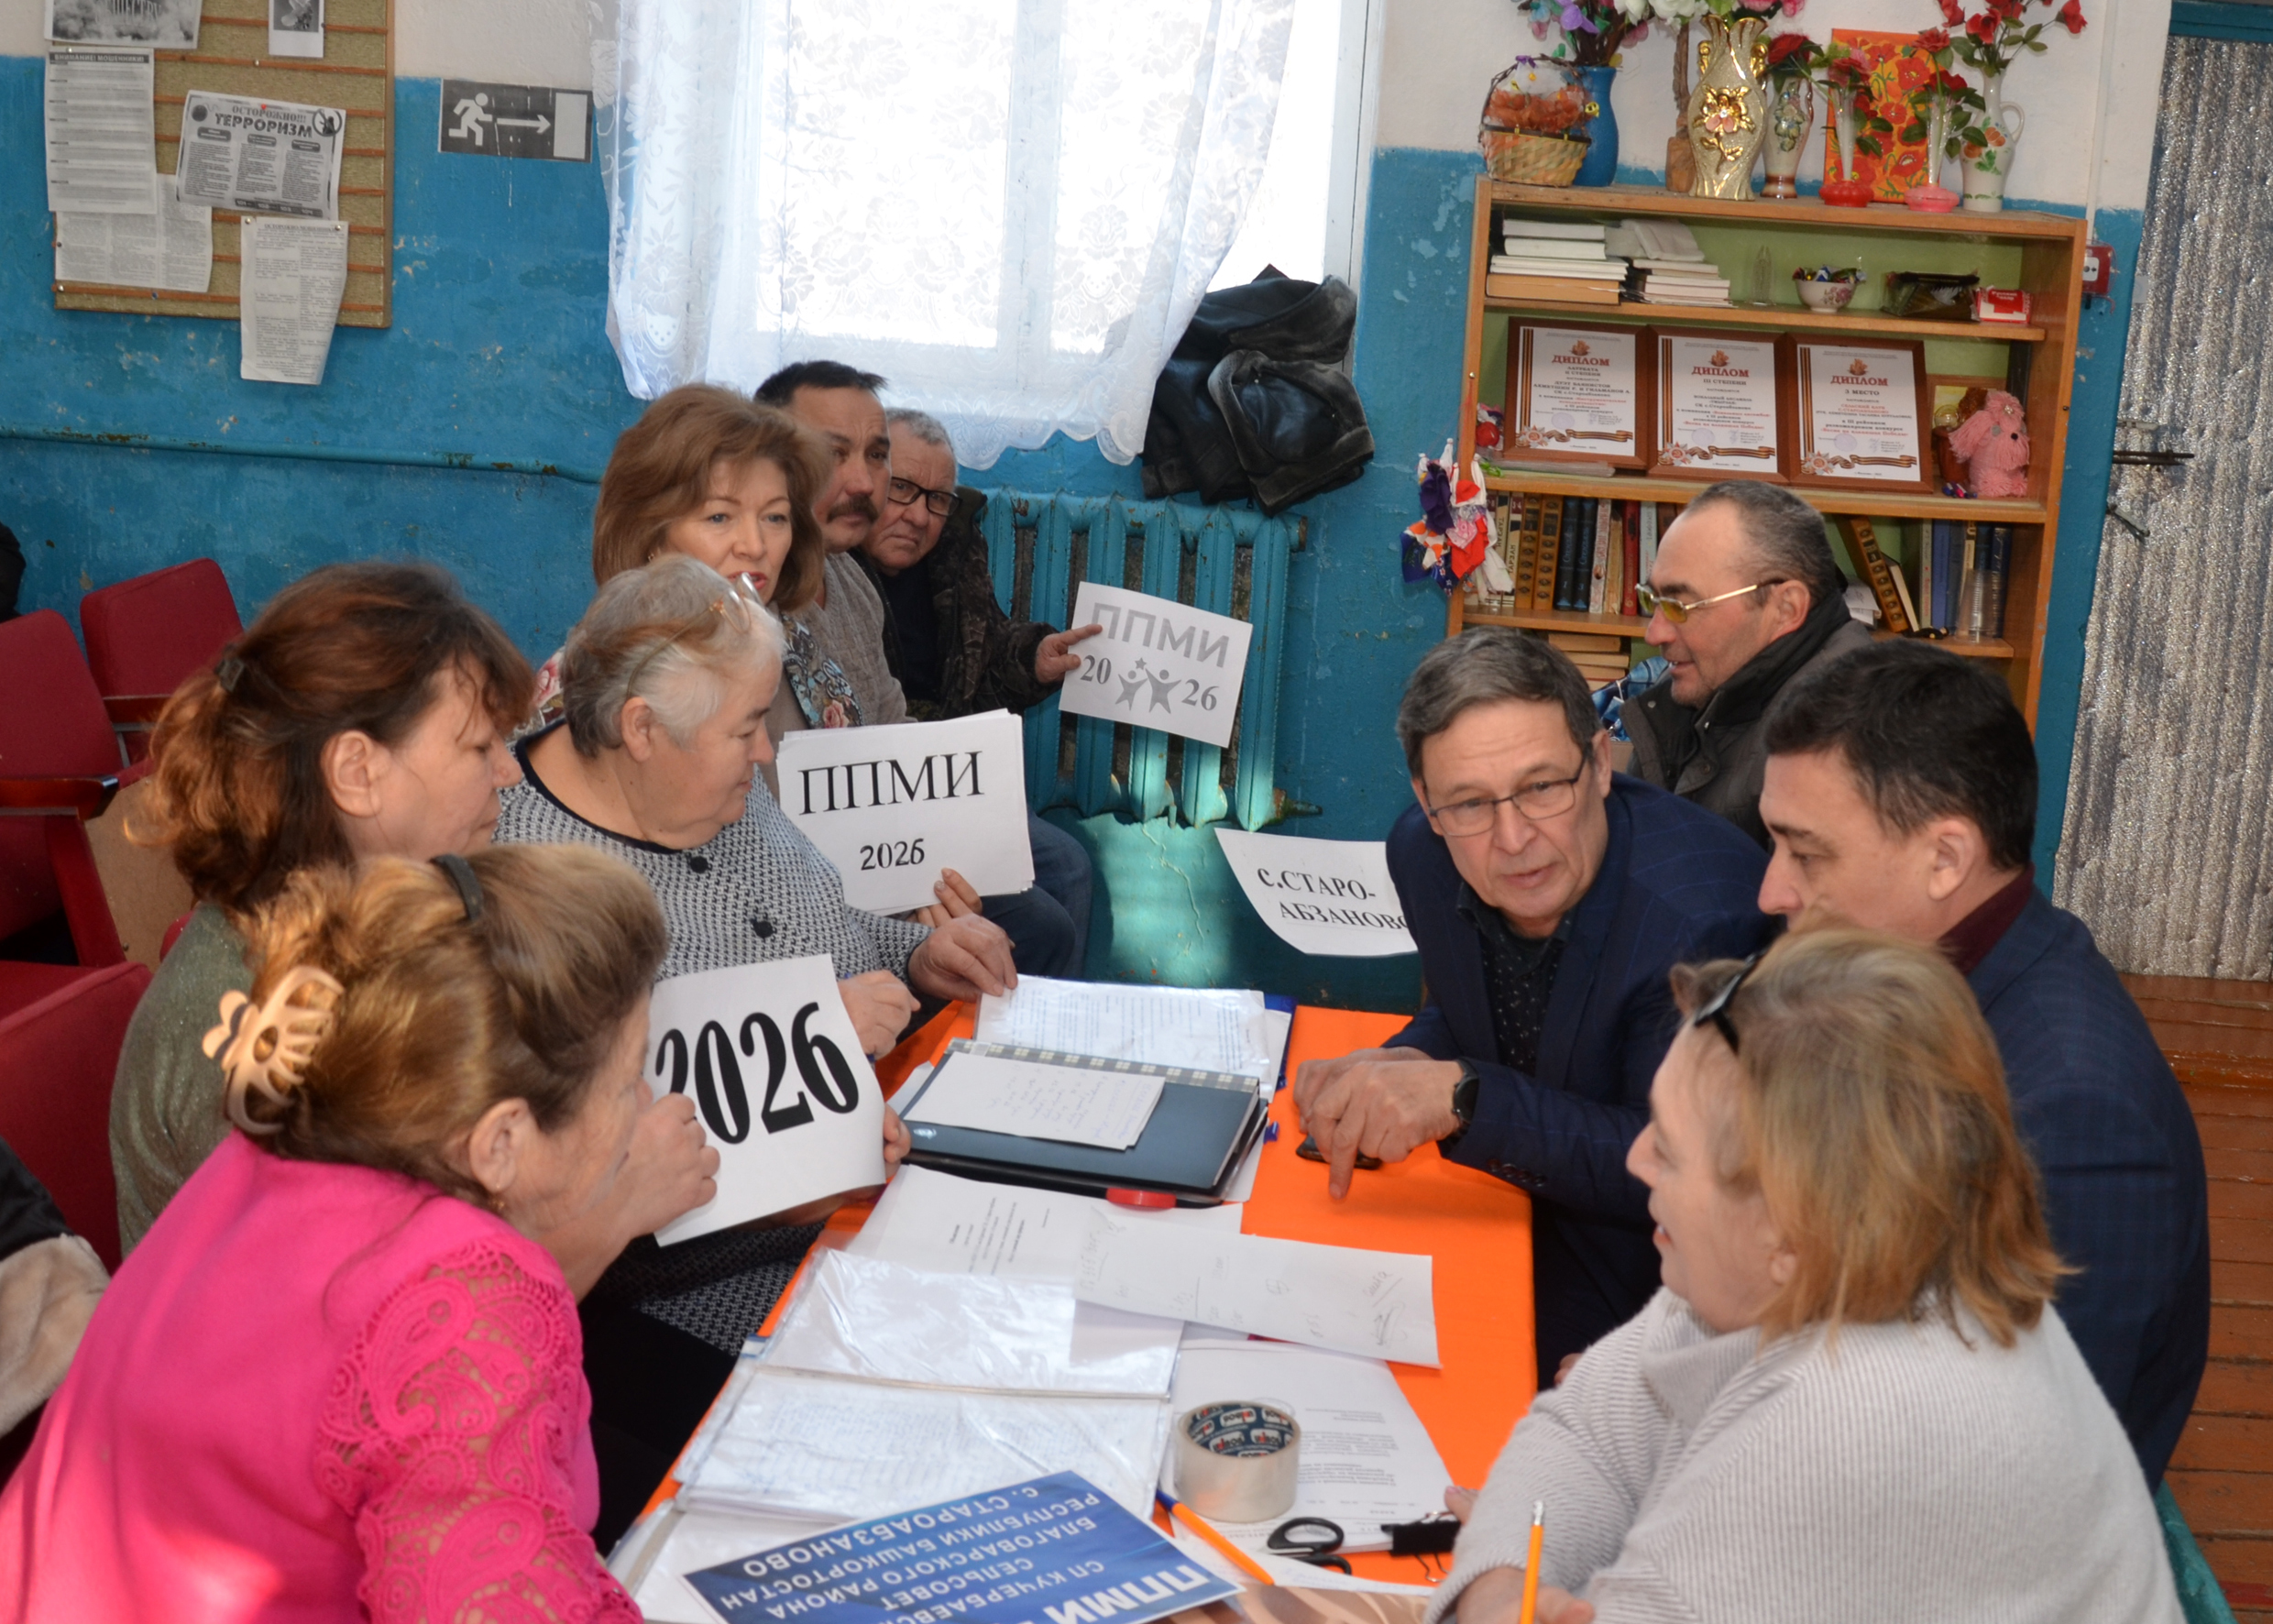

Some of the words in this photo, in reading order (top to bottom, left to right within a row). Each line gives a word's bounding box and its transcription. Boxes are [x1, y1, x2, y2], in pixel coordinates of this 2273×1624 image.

[215, 113, 313, 138] ТЕРРОРИЗМ
[232, 105, 306, 123] ОСТОРОЖНО!!!
[1551, 355, 1610, 366] ДИПЛОМ
[1691, 366, 1750, 378] ДИПЛОМ
[1829, 375, 1888, 386] ДИПЛОМ
[1506, 544, 1517, 574] ТАРЗАН
[1091, 602, 1230, 668] ППМИ
[1080, 654, 1112, 685] 20
[1181, 678, 1221, 711] 26
[797, 751, 984, 816] ППМИ
[860, 838, 925, 871] 2026
[1257, 868, 1377, 900] с.СТАРО-
[654, 1002, 860, 1145] 2026
[1012, 1487, 1038, 1498] с.
[743, 1496, 1009, 1576] СТАРОАБЗАНОВО
[938, 1492, 1101, 1546] РЕСПУБЛИКИ
[719, 1538, 938, 1610] БАШКОРТОСТАН
[881, 1516, 1097, 1585] БЛАГОВАРСКОГО
[1067, 1560, 1104, 1578] СП
[765, 1578, 879, 1619] РАЙОНА
[878, 1571, 1067, 1624] КУЧЕРБАЕВС
[881, 1557, 1034, 1611] СЕЛЬСОВЕТ
[1042, 1564, 1211, 1624] ППМИ
